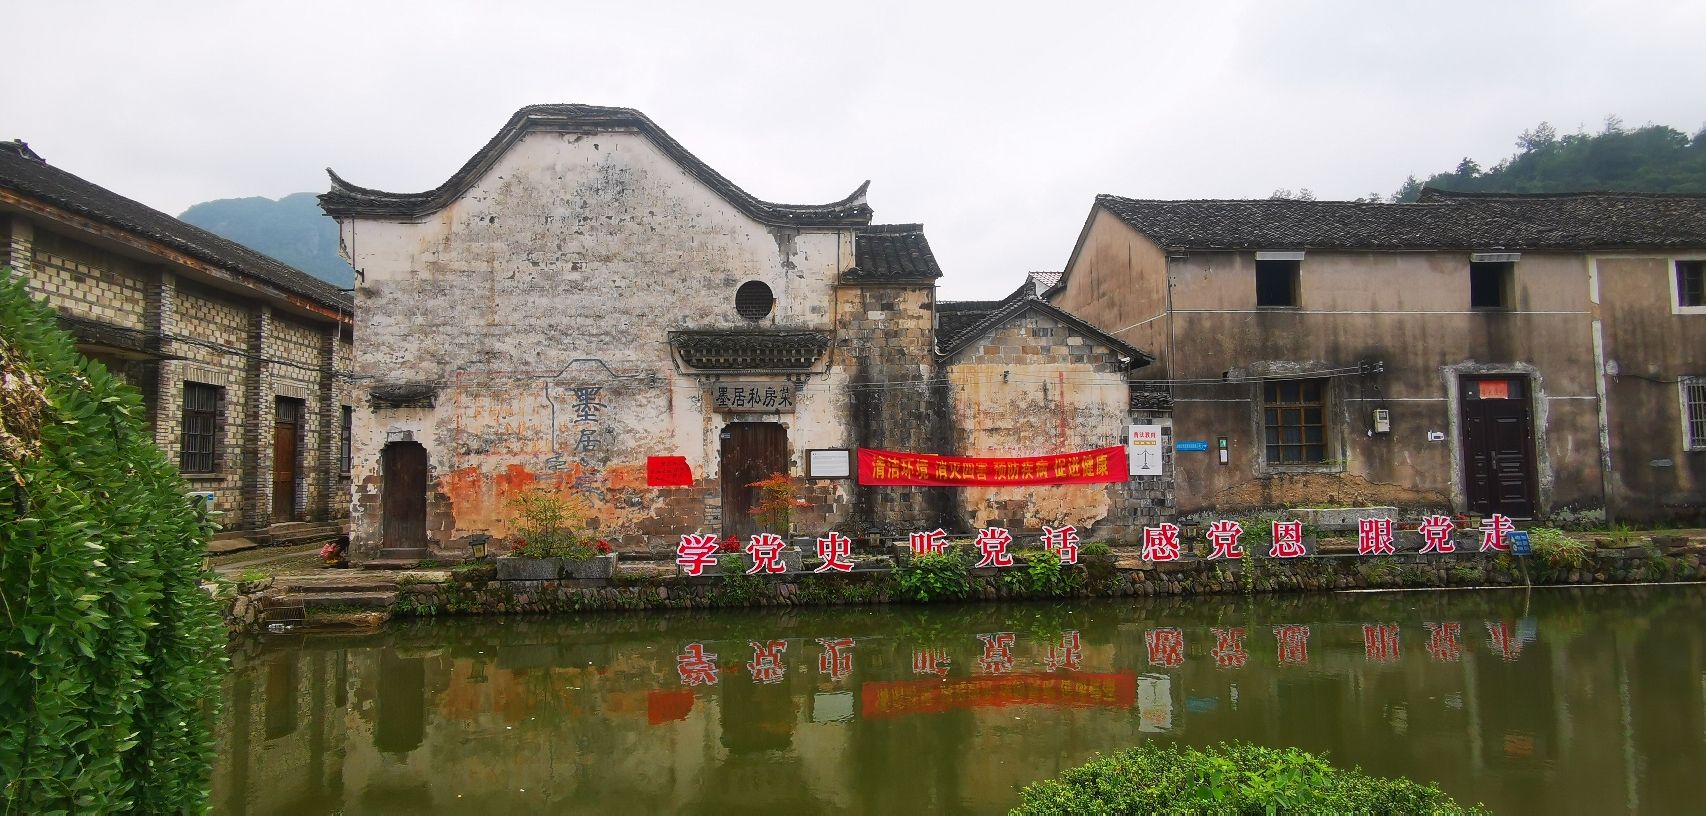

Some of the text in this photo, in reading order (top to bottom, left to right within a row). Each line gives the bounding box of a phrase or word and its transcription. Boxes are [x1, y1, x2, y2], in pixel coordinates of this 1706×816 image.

[715, 386, 793, 408] 墨居私房菜
[872, 455, 928, 480] 清洁环境
[935, 460, 987, 481] 消灭四害
[993, 460, 1048, 480] 预防疾病
[1054, 454, 1108, 477] 促进健康
[676, 513, 1516, 577] 学党史 听党话 感党恩 跟党走
